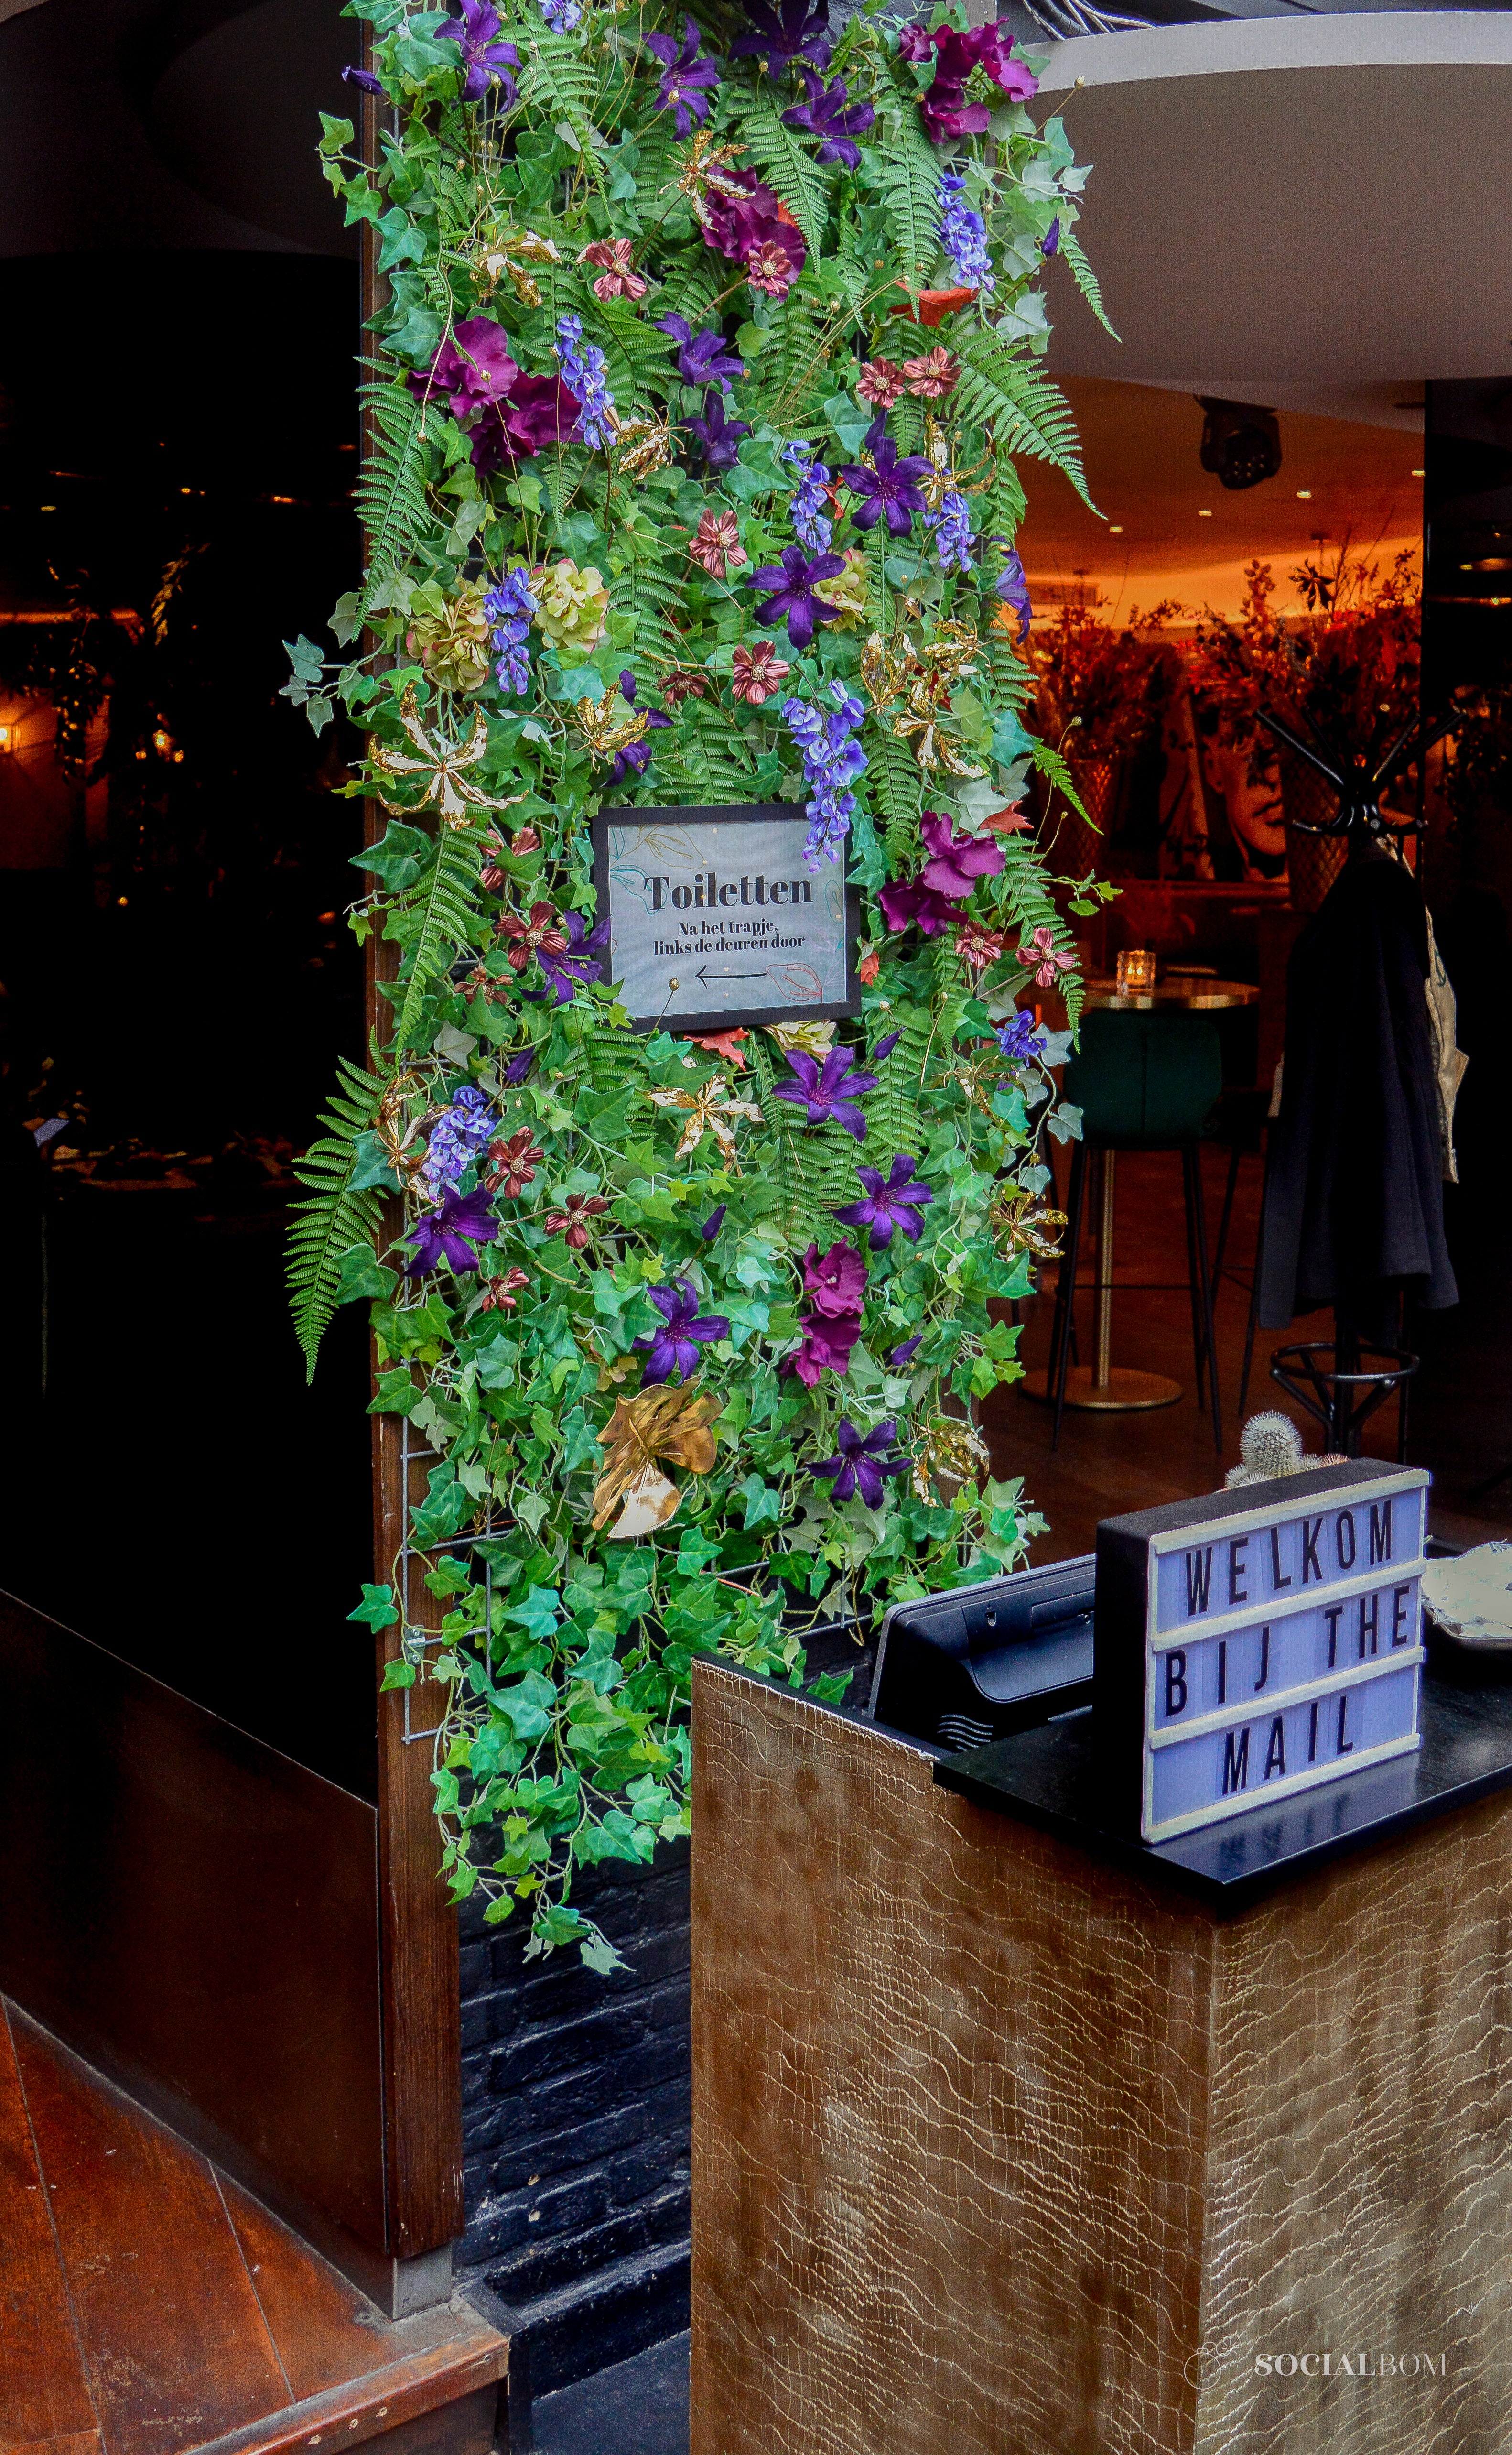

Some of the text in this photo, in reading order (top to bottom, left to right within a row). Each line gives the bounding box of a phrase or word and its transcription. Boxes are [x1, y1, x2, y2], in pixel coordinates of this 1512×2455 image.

[644, 872, 813, 910] Toiletten
[654, 934, 805, 955] links de deuren door
[678, 918, 779, 936] Na het trapje,
[1186, 1500, 1393, 1617] WELKOM
[1165, 1585, 1410, 1717] BIJ THE
[1221, 1695, 1353, 1795] MAIL
